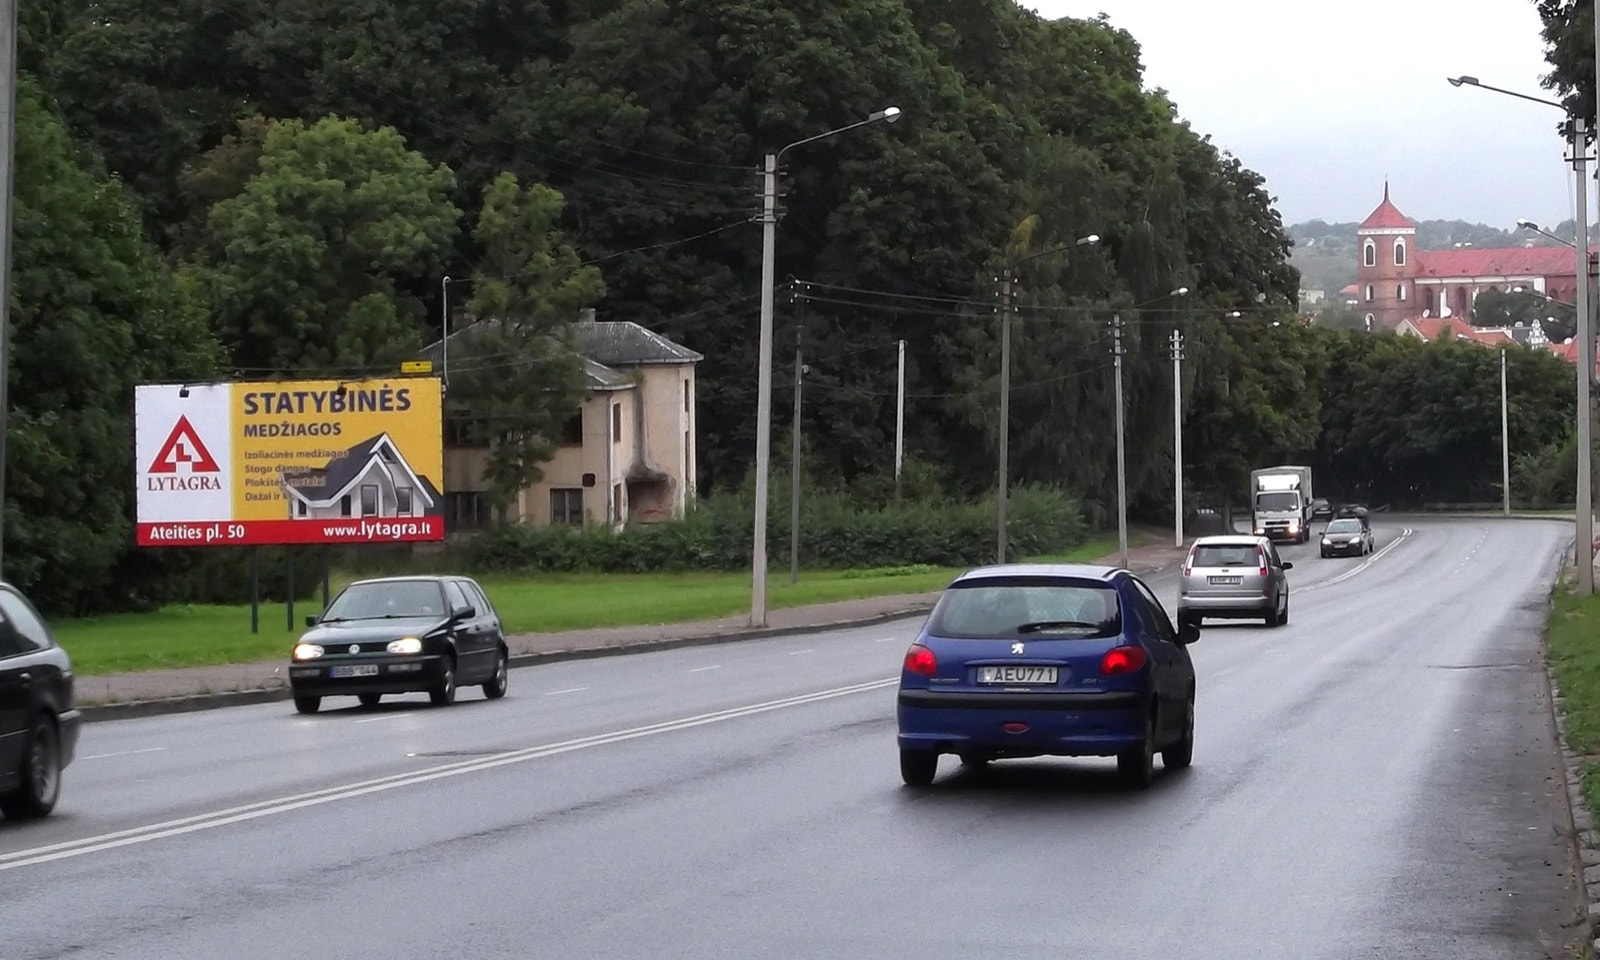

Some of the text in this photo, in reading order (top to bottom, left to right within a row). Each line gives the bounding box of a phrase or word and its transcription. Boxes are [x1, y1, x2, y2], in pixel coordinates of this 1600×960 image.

[244, 384, 411, 415] STATYBINĖS
[244, 421, 342, 438] MEDŽIAGOS
[245, 464, 273, 475] Stogo
[147, 476, 222, 491] LYTAGRA
[150, 523, 245, 543] Ateities pl. 50
[323, 520, 431, 539] www.lytagra.lt
[993, 667, 1055, 682] AEU771
